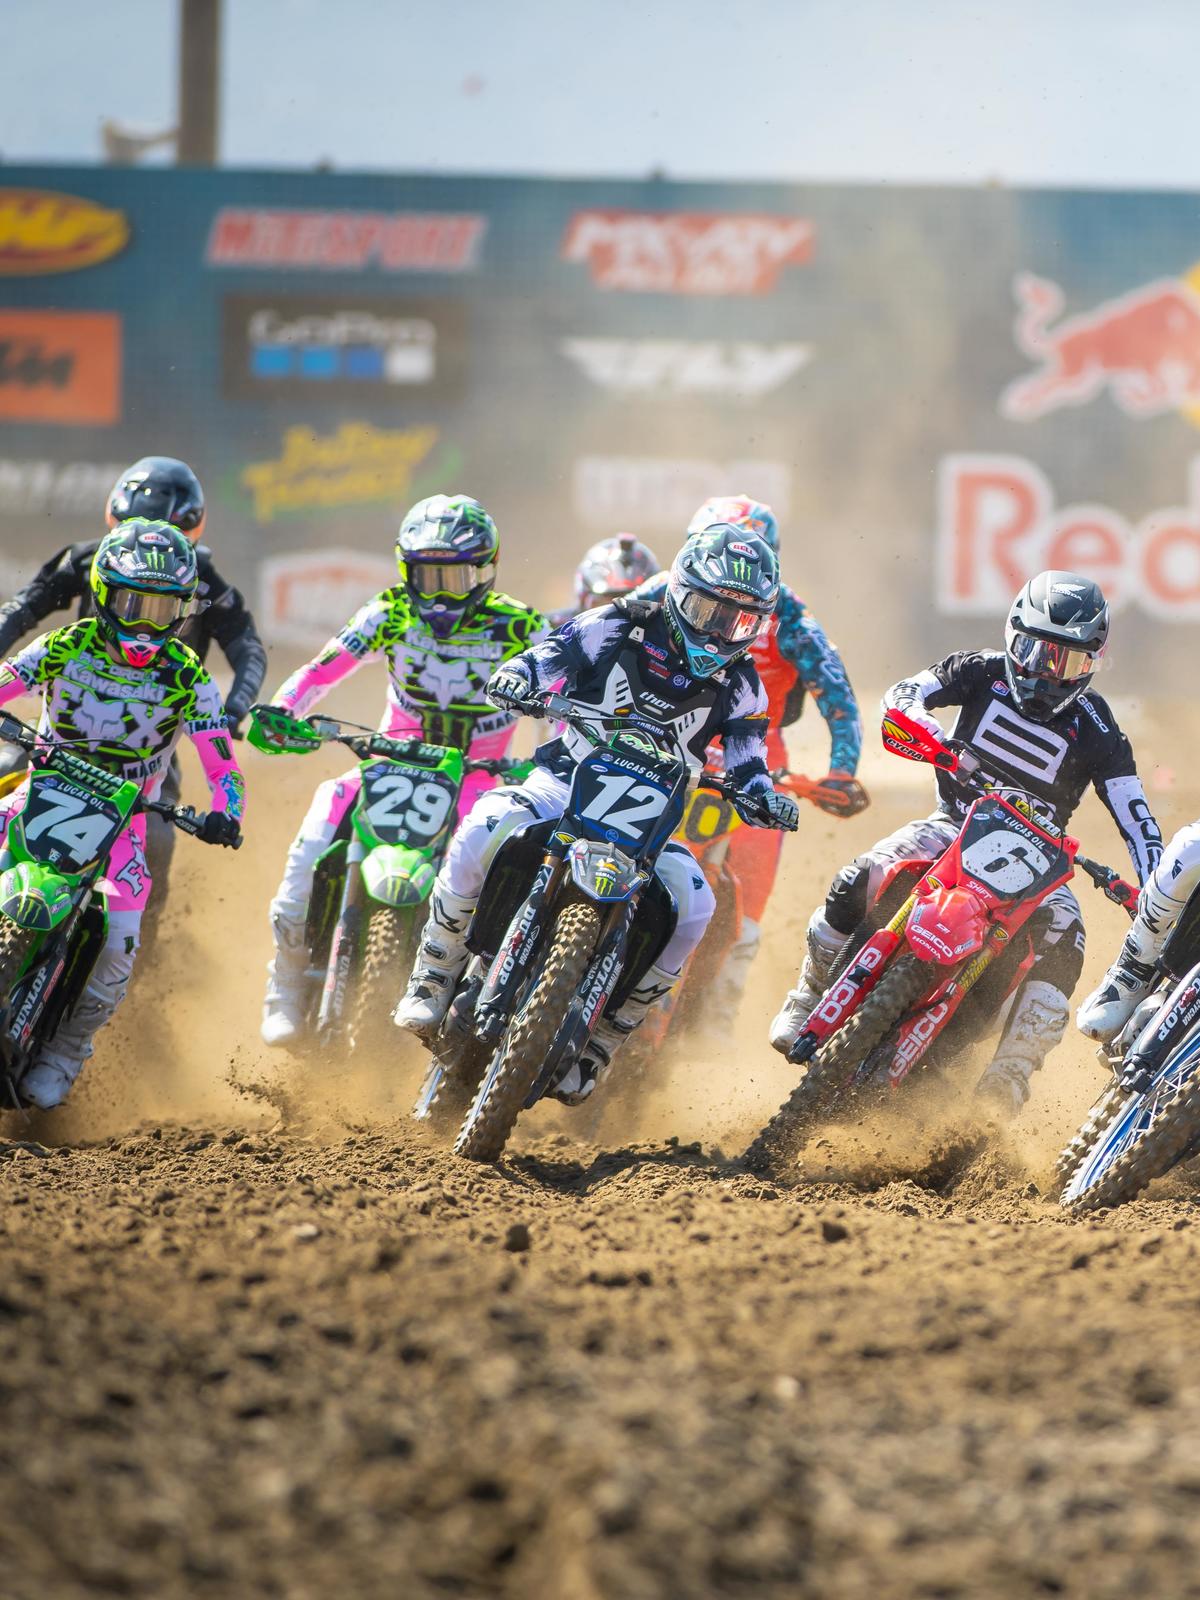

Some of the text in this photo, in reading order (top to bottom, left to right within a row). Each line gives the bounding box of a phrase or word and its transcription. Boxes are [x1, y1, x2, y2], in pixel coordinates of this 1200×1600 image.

[249, 311, 436, 346] GoPro
[733, 543, 753, 555] BELL
[1051, 588, 1083, 601] HONDA
[63, 660, 166, 702] Kawasaki
[640, 691, 675, 710] thor
[1077, 694, 1109, 733] GEICO
[887, 738, 924, 761] CYCRA
[387, 766, 437, 782] LUCAS OIL
[614, 758, 661, 783] LUCAS OIL
[57, 782, 105, 810] LUCAS OIL
[366, 775, 452, 837] 29
[581, 774, 669, 840] 12
[25, 788, 116, 867] 74
[1003, 816, 1046, 850] LUCAS OIL
[961, 829, 1051, 894] 6
[966, 880, 993, 900] SHIFT
[499, 904, 537, 986] DULOP
[518, 938, 535, 966] CYCRA
[911, 924, 954, 958] GEICO
[912, 935, 941, 959] HONDA
[10, 966, 47, 1040] DUNLOP
[818, 947, 882, 1025] GICO
[889, 1003, 948, 1078] GEICO
